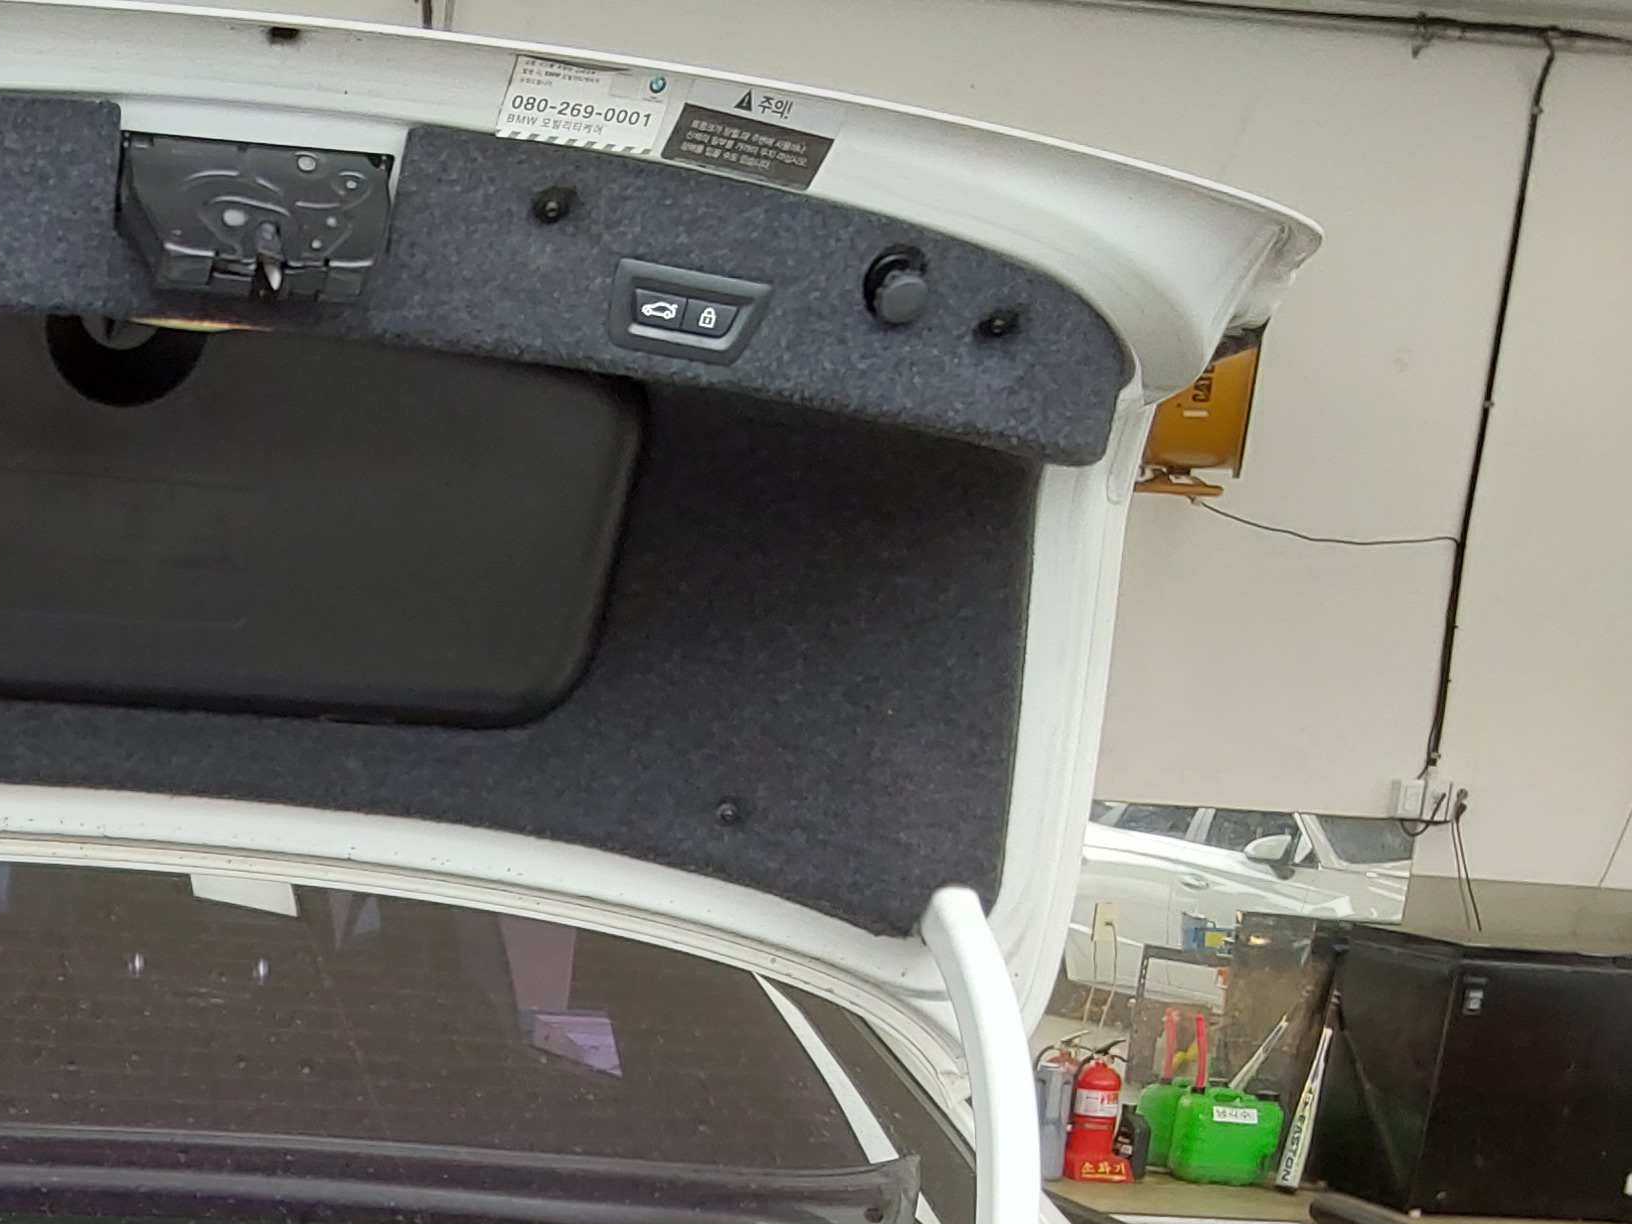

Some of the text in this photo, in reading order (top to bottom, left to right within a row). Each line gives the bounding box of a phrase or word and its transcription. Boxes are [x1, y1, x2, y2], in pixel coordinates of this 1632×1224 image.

[511, 95, 652, 128] 080-269-0001
[758, 95, 793, 121] 주의!
[506, 113, 604, 136] BMW 모빌리티케어
[1282, 1114, 1306, 1183] EASTON
